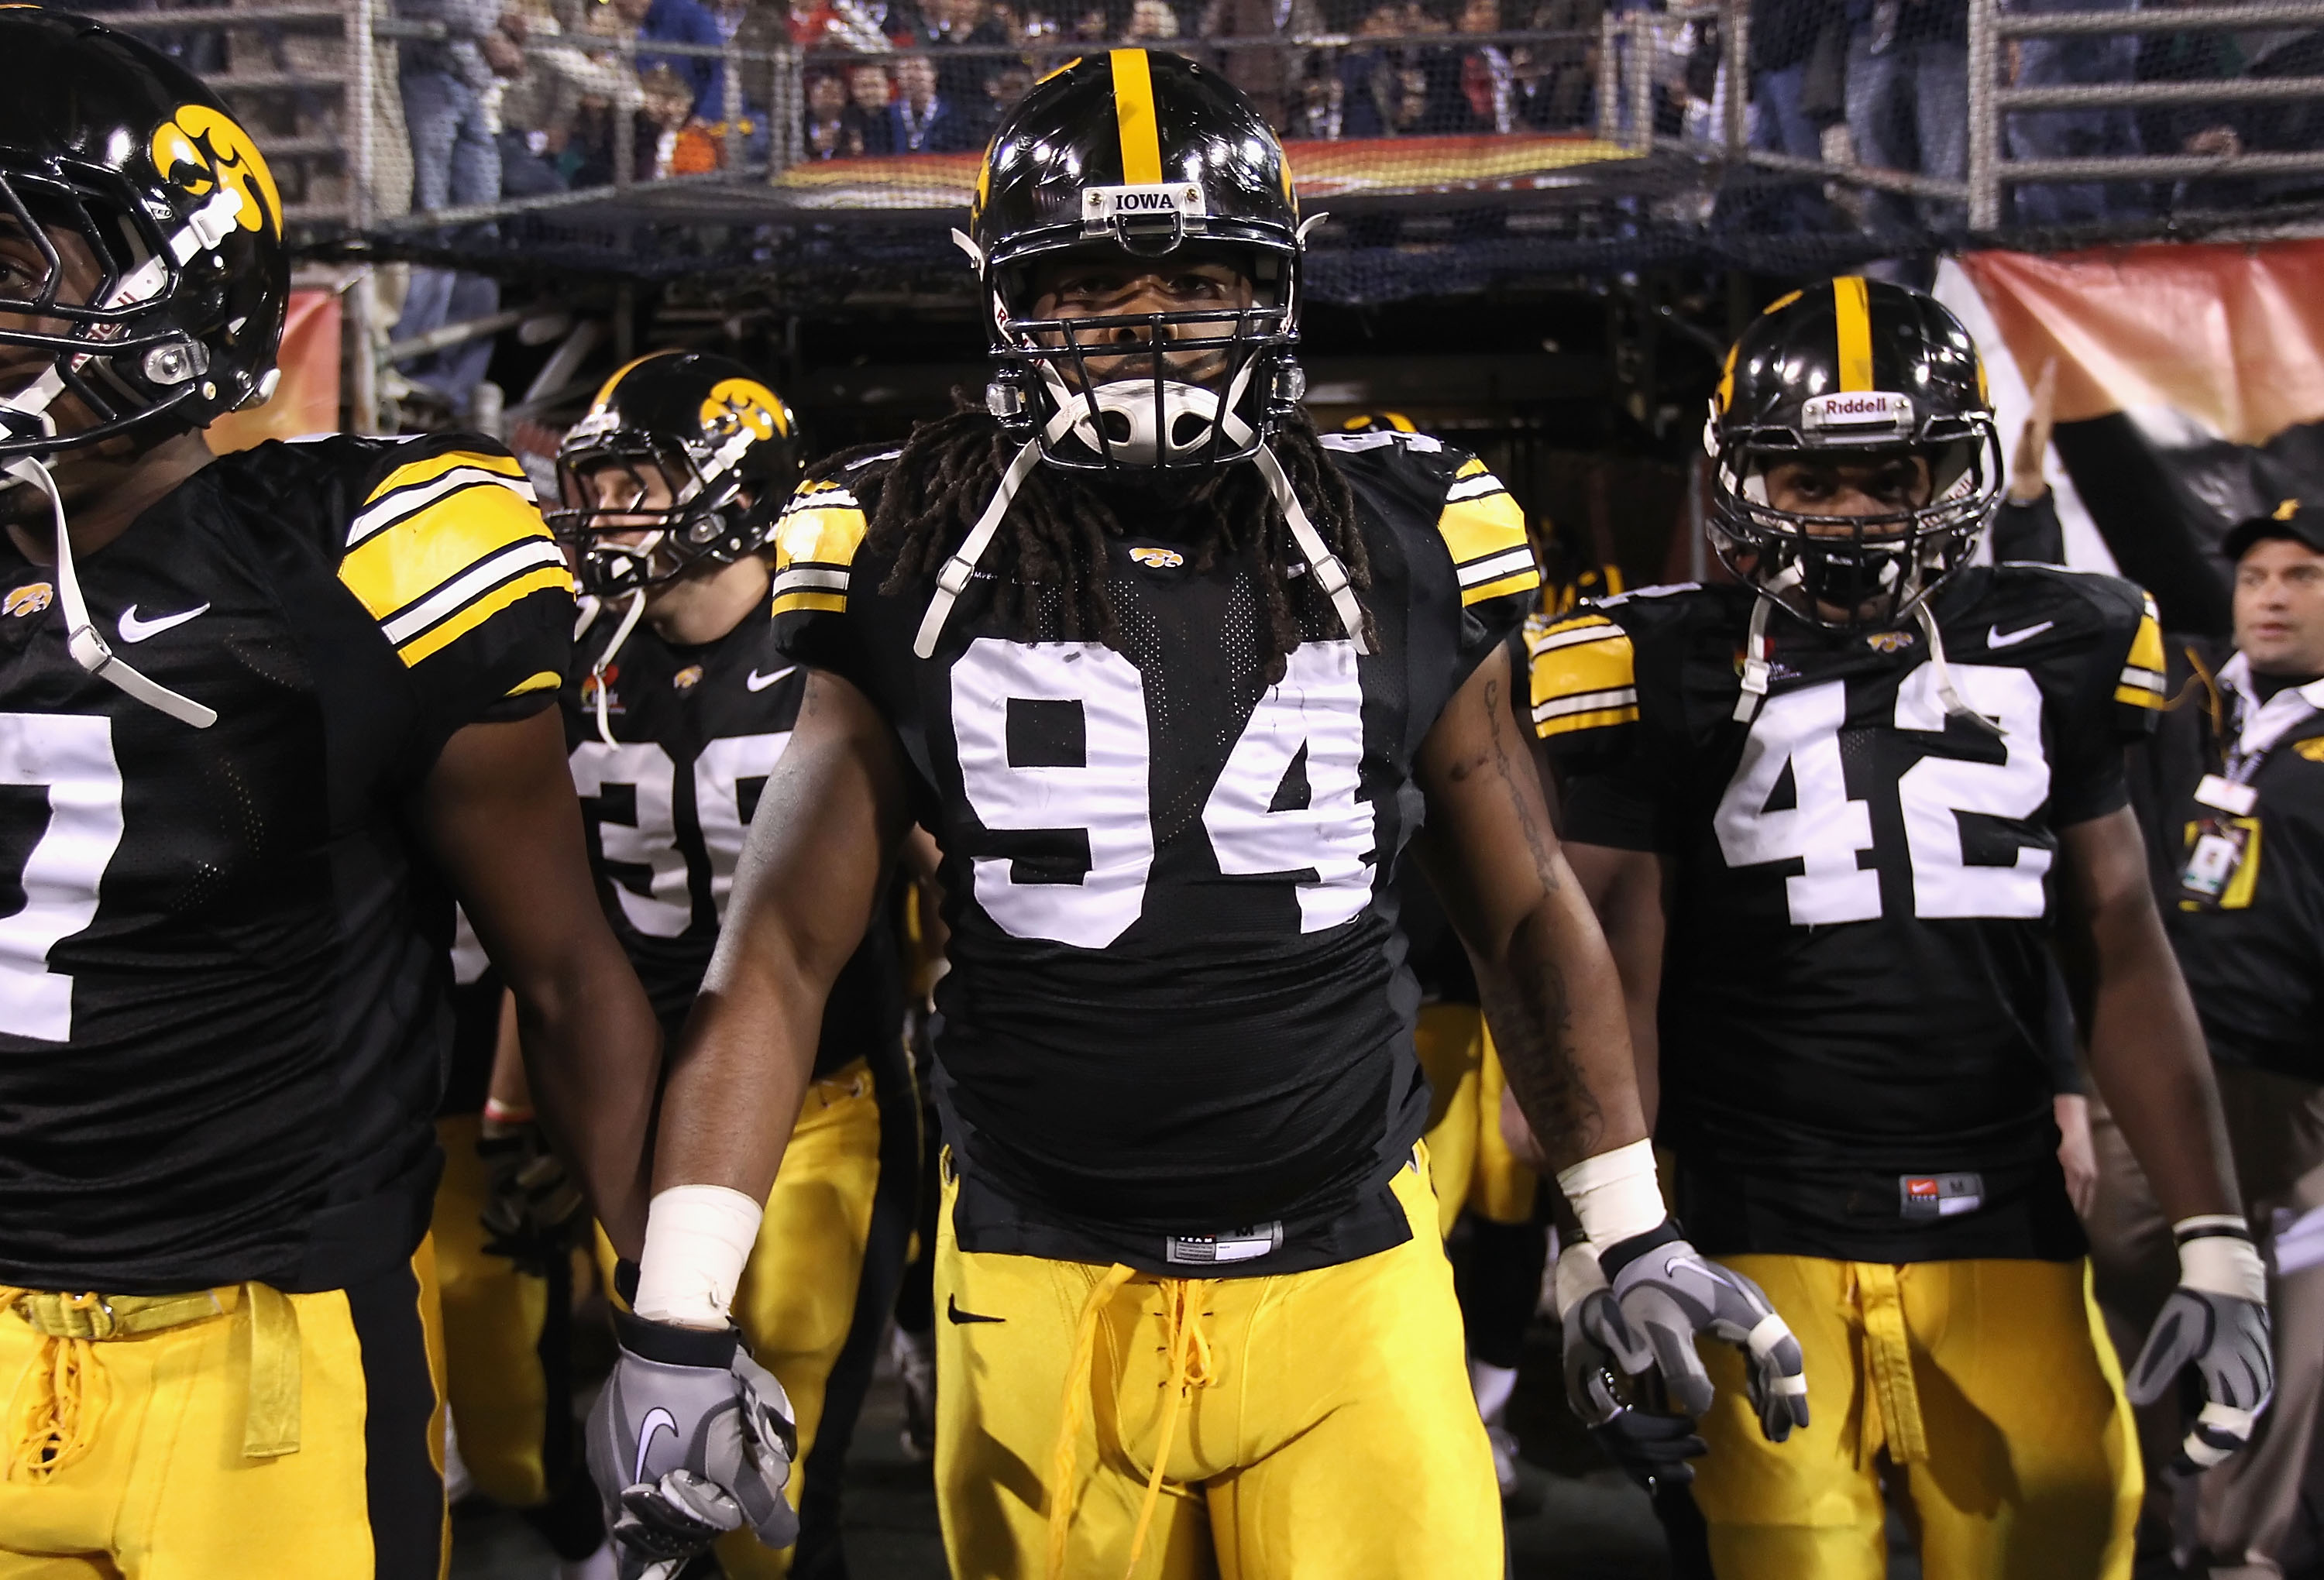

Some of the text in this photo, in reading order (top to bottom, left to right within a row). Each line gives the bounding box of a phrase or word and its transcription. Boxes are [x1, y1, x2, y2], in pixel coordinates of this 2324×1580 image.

[1116, 194, 1174, 210] IOWA
[1826, 397, 1886, 414] Riddell
[951, 637, 1377, 950] 94
[1713, 661, 2051, 926] 42
